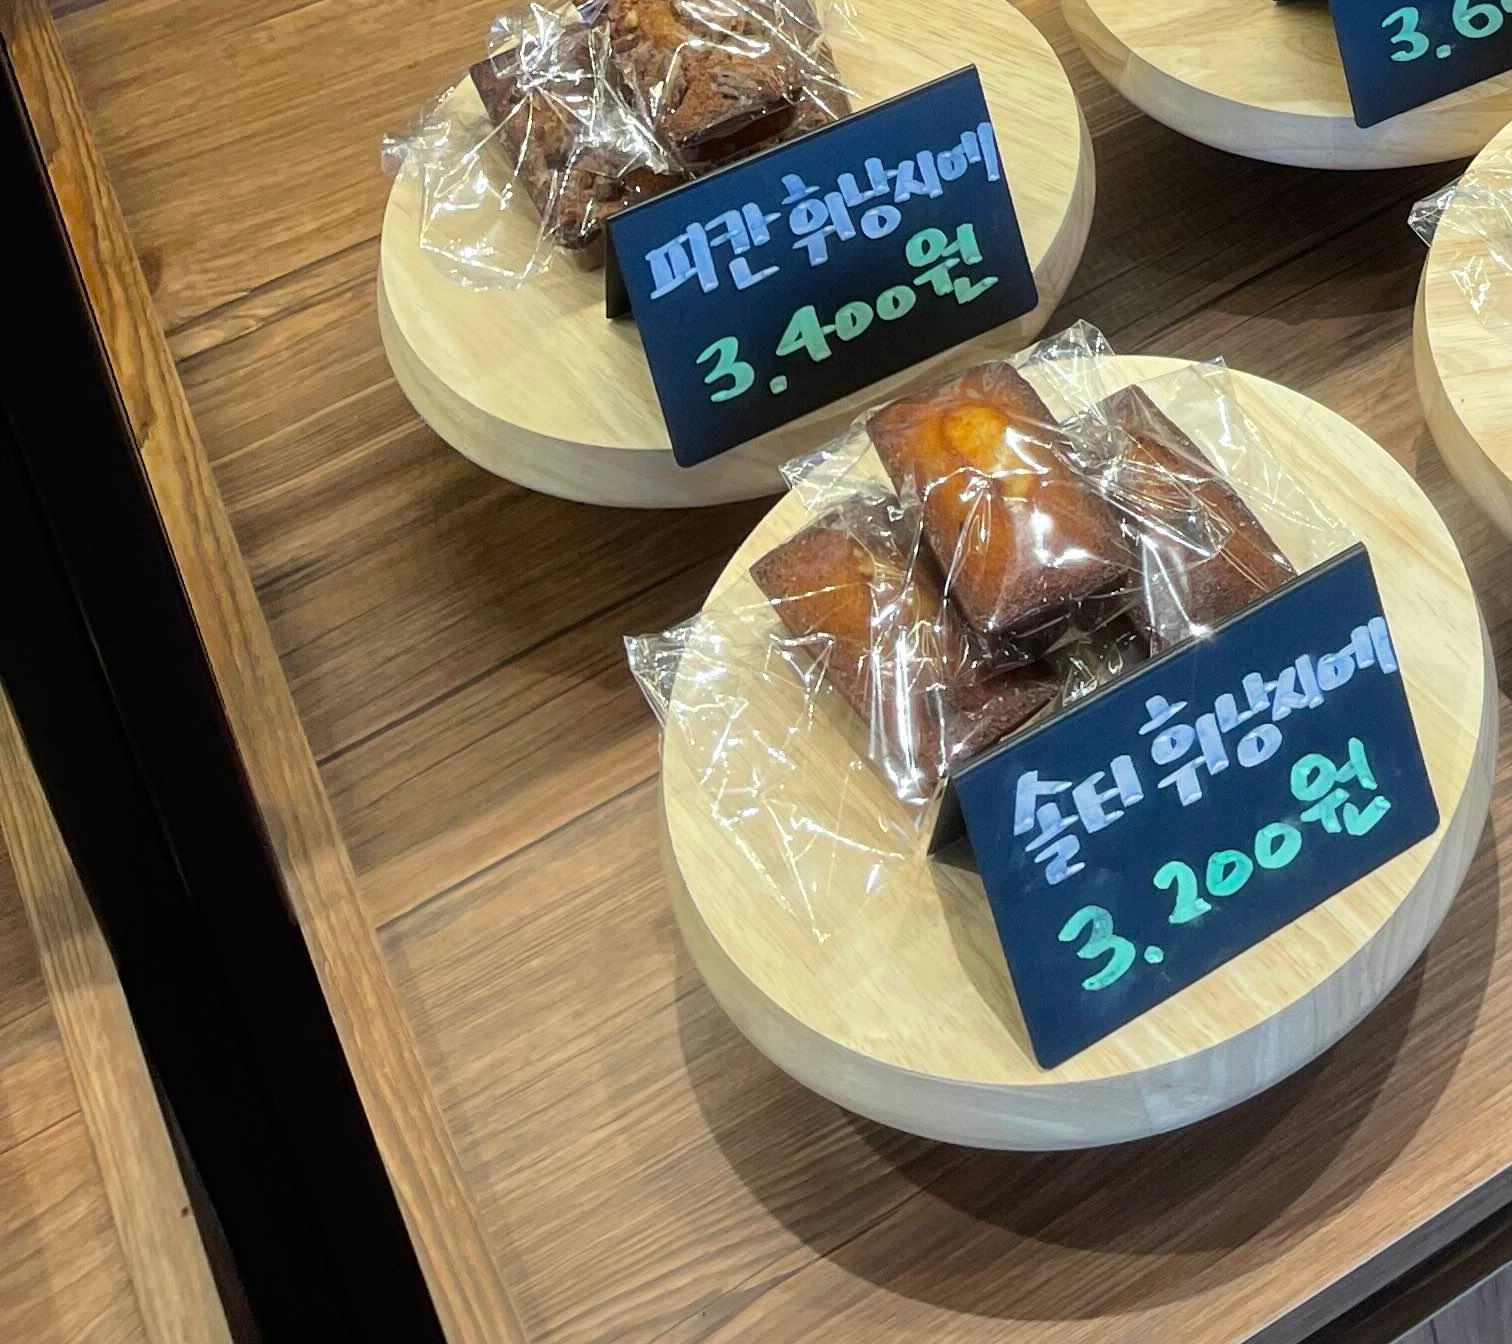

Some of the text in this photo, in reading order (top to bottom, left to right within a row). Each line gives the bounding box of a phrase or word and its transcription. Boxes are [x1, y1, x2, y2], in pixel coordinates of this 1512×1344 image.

[696, 223, 999, 403] 3.400원
[1012, 615, 1398, 886] 솔티 휘낭시에
[1057, 737, 1392, 991] 3.200원
